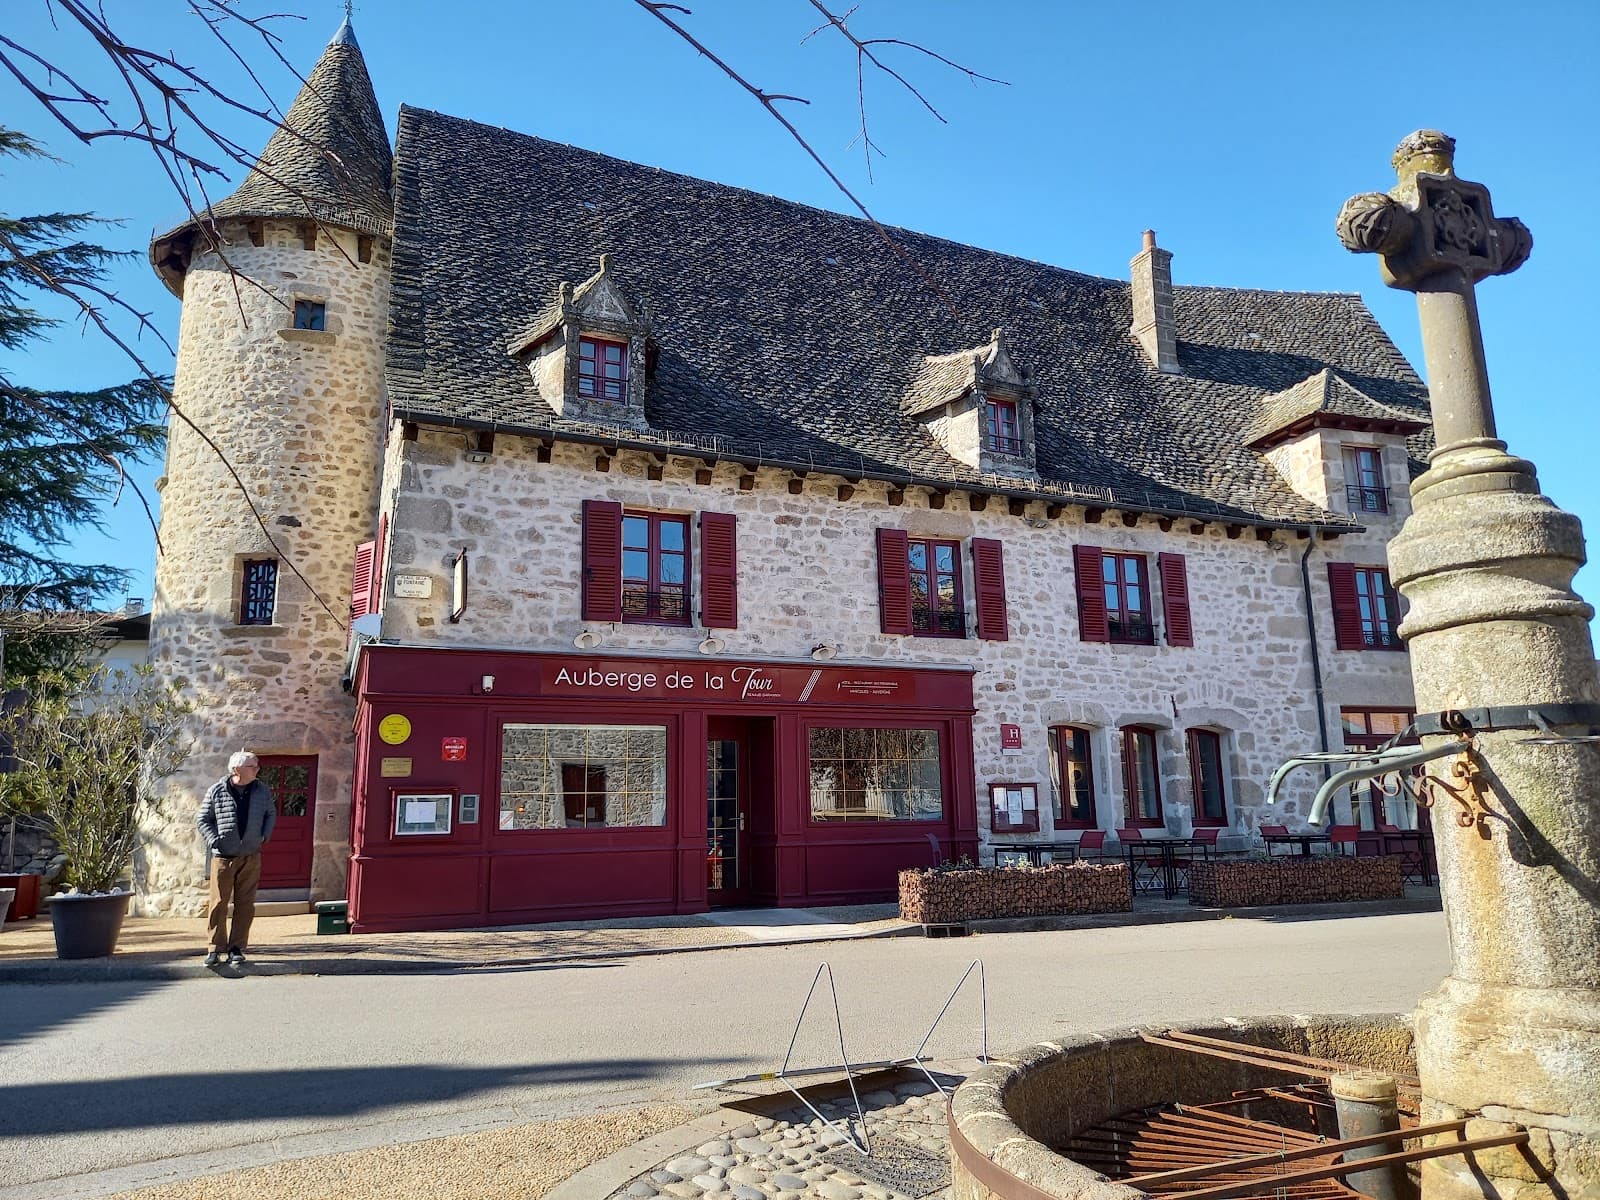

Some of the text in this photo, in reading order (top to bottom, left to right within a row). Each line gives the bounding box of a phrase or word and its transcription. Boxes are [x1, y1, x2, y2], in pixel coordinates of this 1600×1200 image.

[554, 666, 773, 700] Auberge de la Tour
[1010, 728, 1019, 738] H
